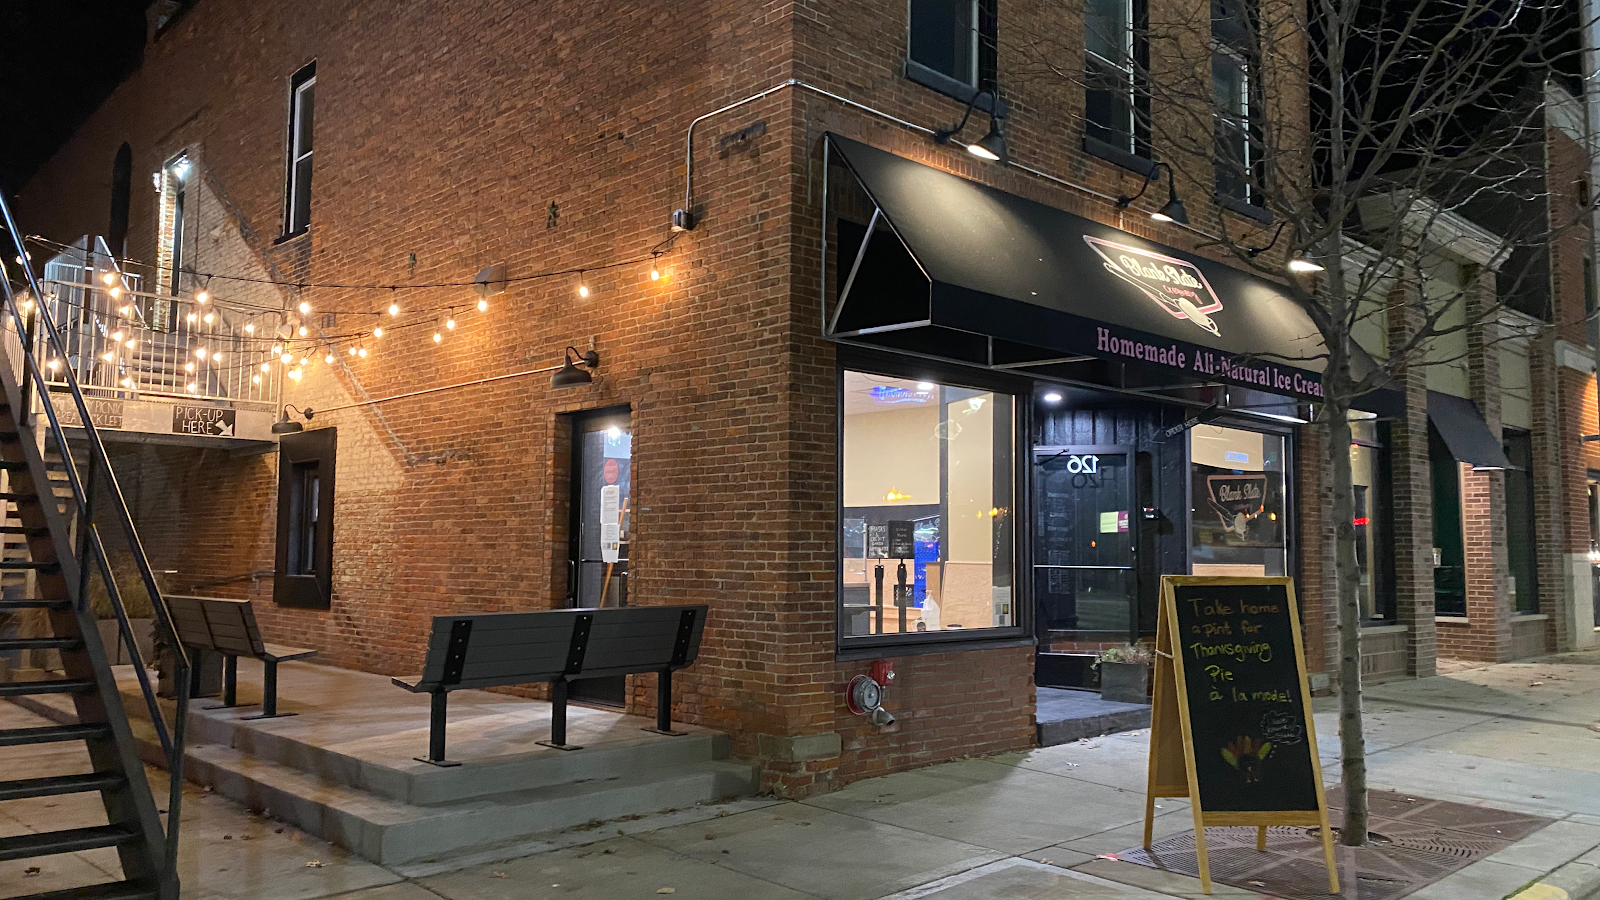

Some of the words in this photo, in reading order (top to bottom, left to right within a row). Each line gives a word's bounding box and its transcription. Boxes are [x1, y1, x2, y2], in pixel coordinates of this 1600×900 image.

[1119, 255, 1170, 282] Blank
[1163, 265, 1203, 289] Slate
[1096, 326, 1186, 369] Homemade
[1193, 350, 1270, 386] All-Natural
[1273, 368, 1292, 391] Ice
[1293, 373, 1325, 397] Crea
[175, 406, 224, 421] PICK-UP
[182, 421, 214, 435] HERE
[1187, 598, 1232, 617] Take
[1240, 600, 1279, 614] home
[1191, 625, 1201, 634] a
[1241, 620, 1264, 635] for
[1189, 641, 1272, 662] Thanksgiving
[1204, 664, 1234, 682] Pie
[1232, 687, 1248, 702] la
